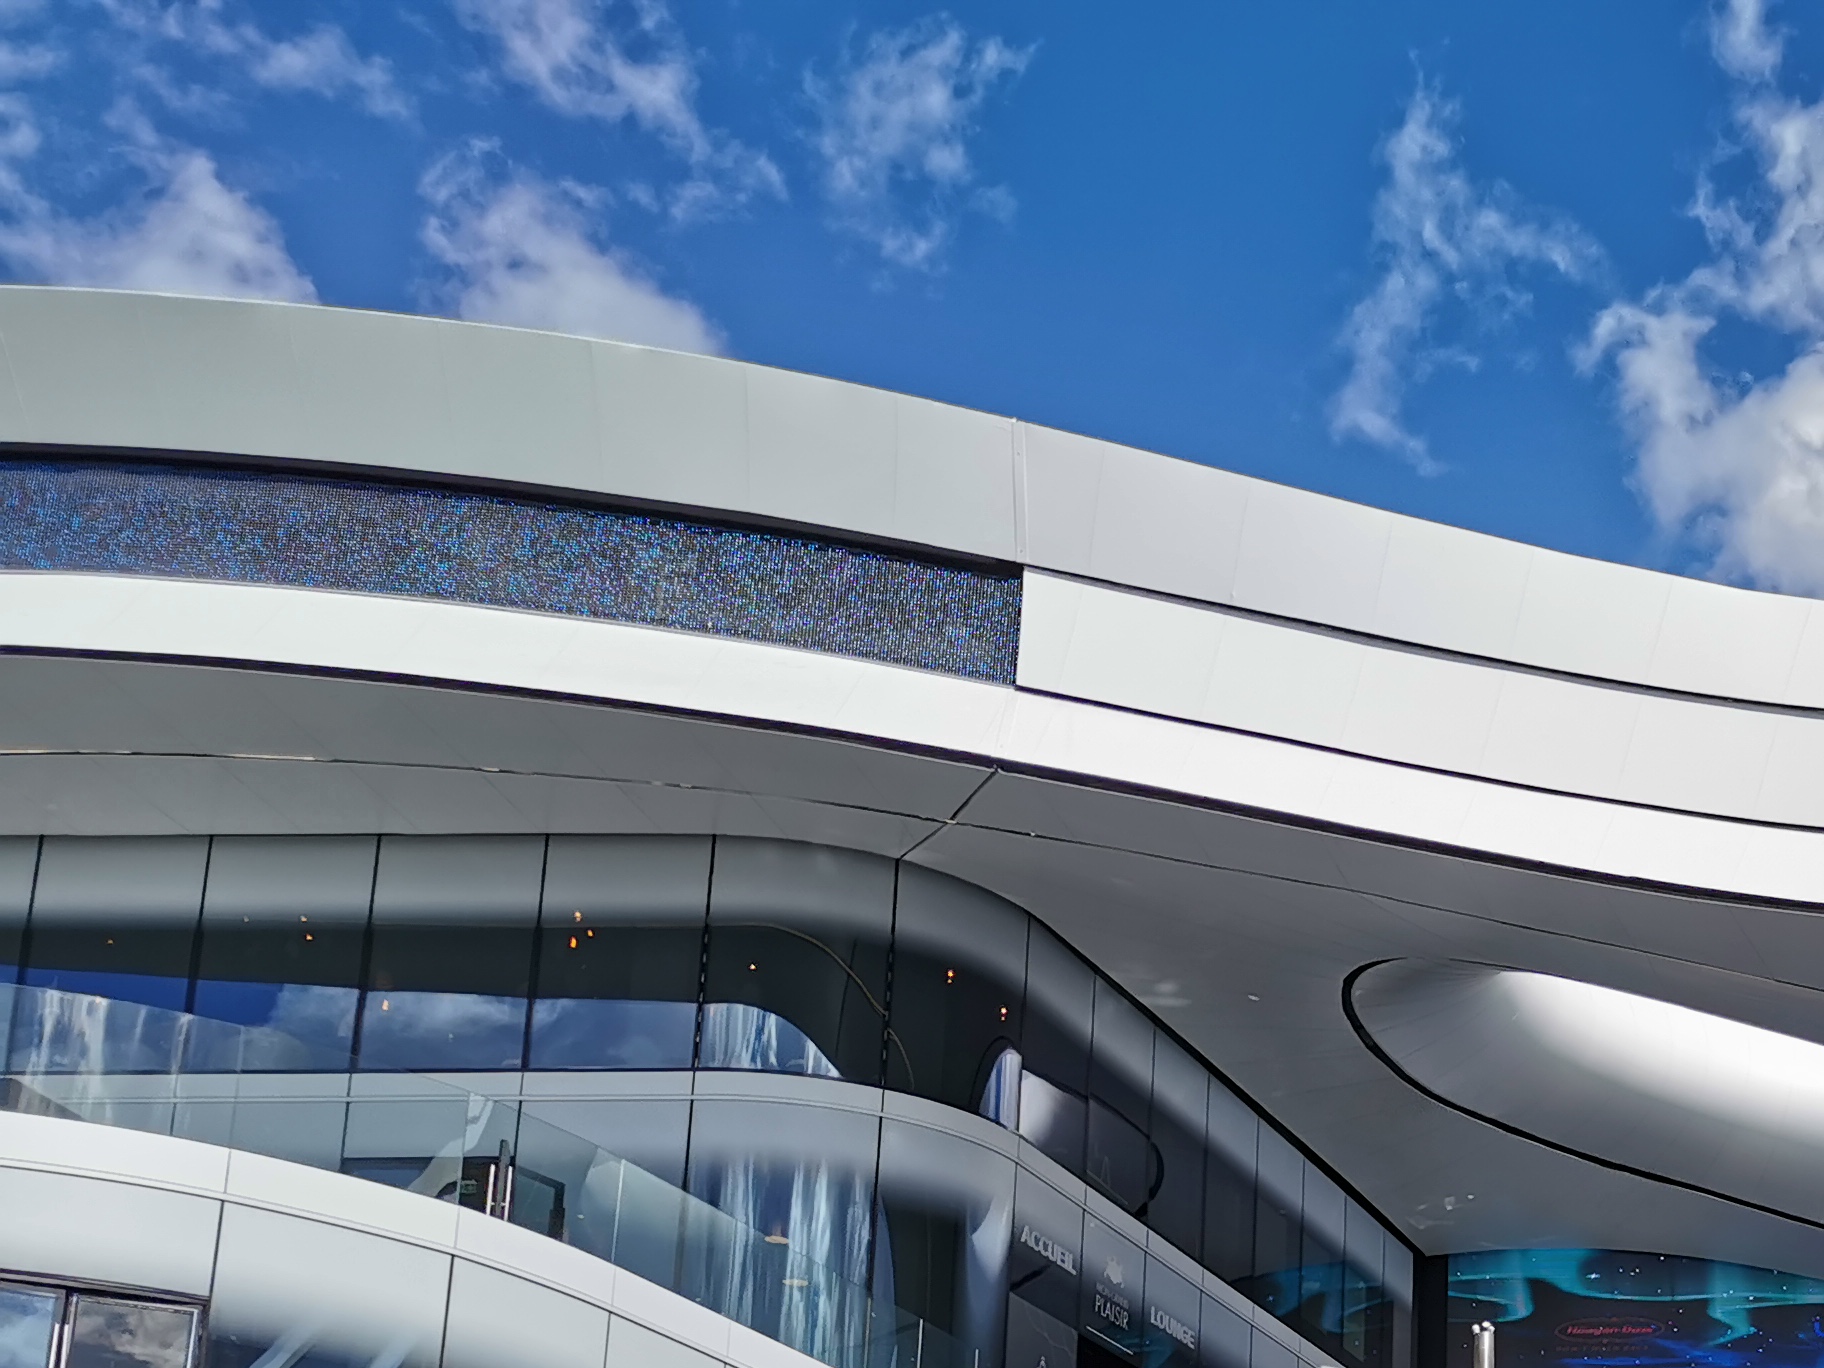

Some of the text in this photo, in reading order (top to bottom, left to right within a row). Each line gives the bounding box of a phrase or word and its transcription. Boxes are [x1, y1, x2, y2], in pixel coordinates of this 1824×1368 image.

[1020, 1225, 1077, 1276] ACCUEIL
[1095, 1294, 1129, 1331] PLAISIR
[1151, 1306, 1196, 1350] LOUNGE
